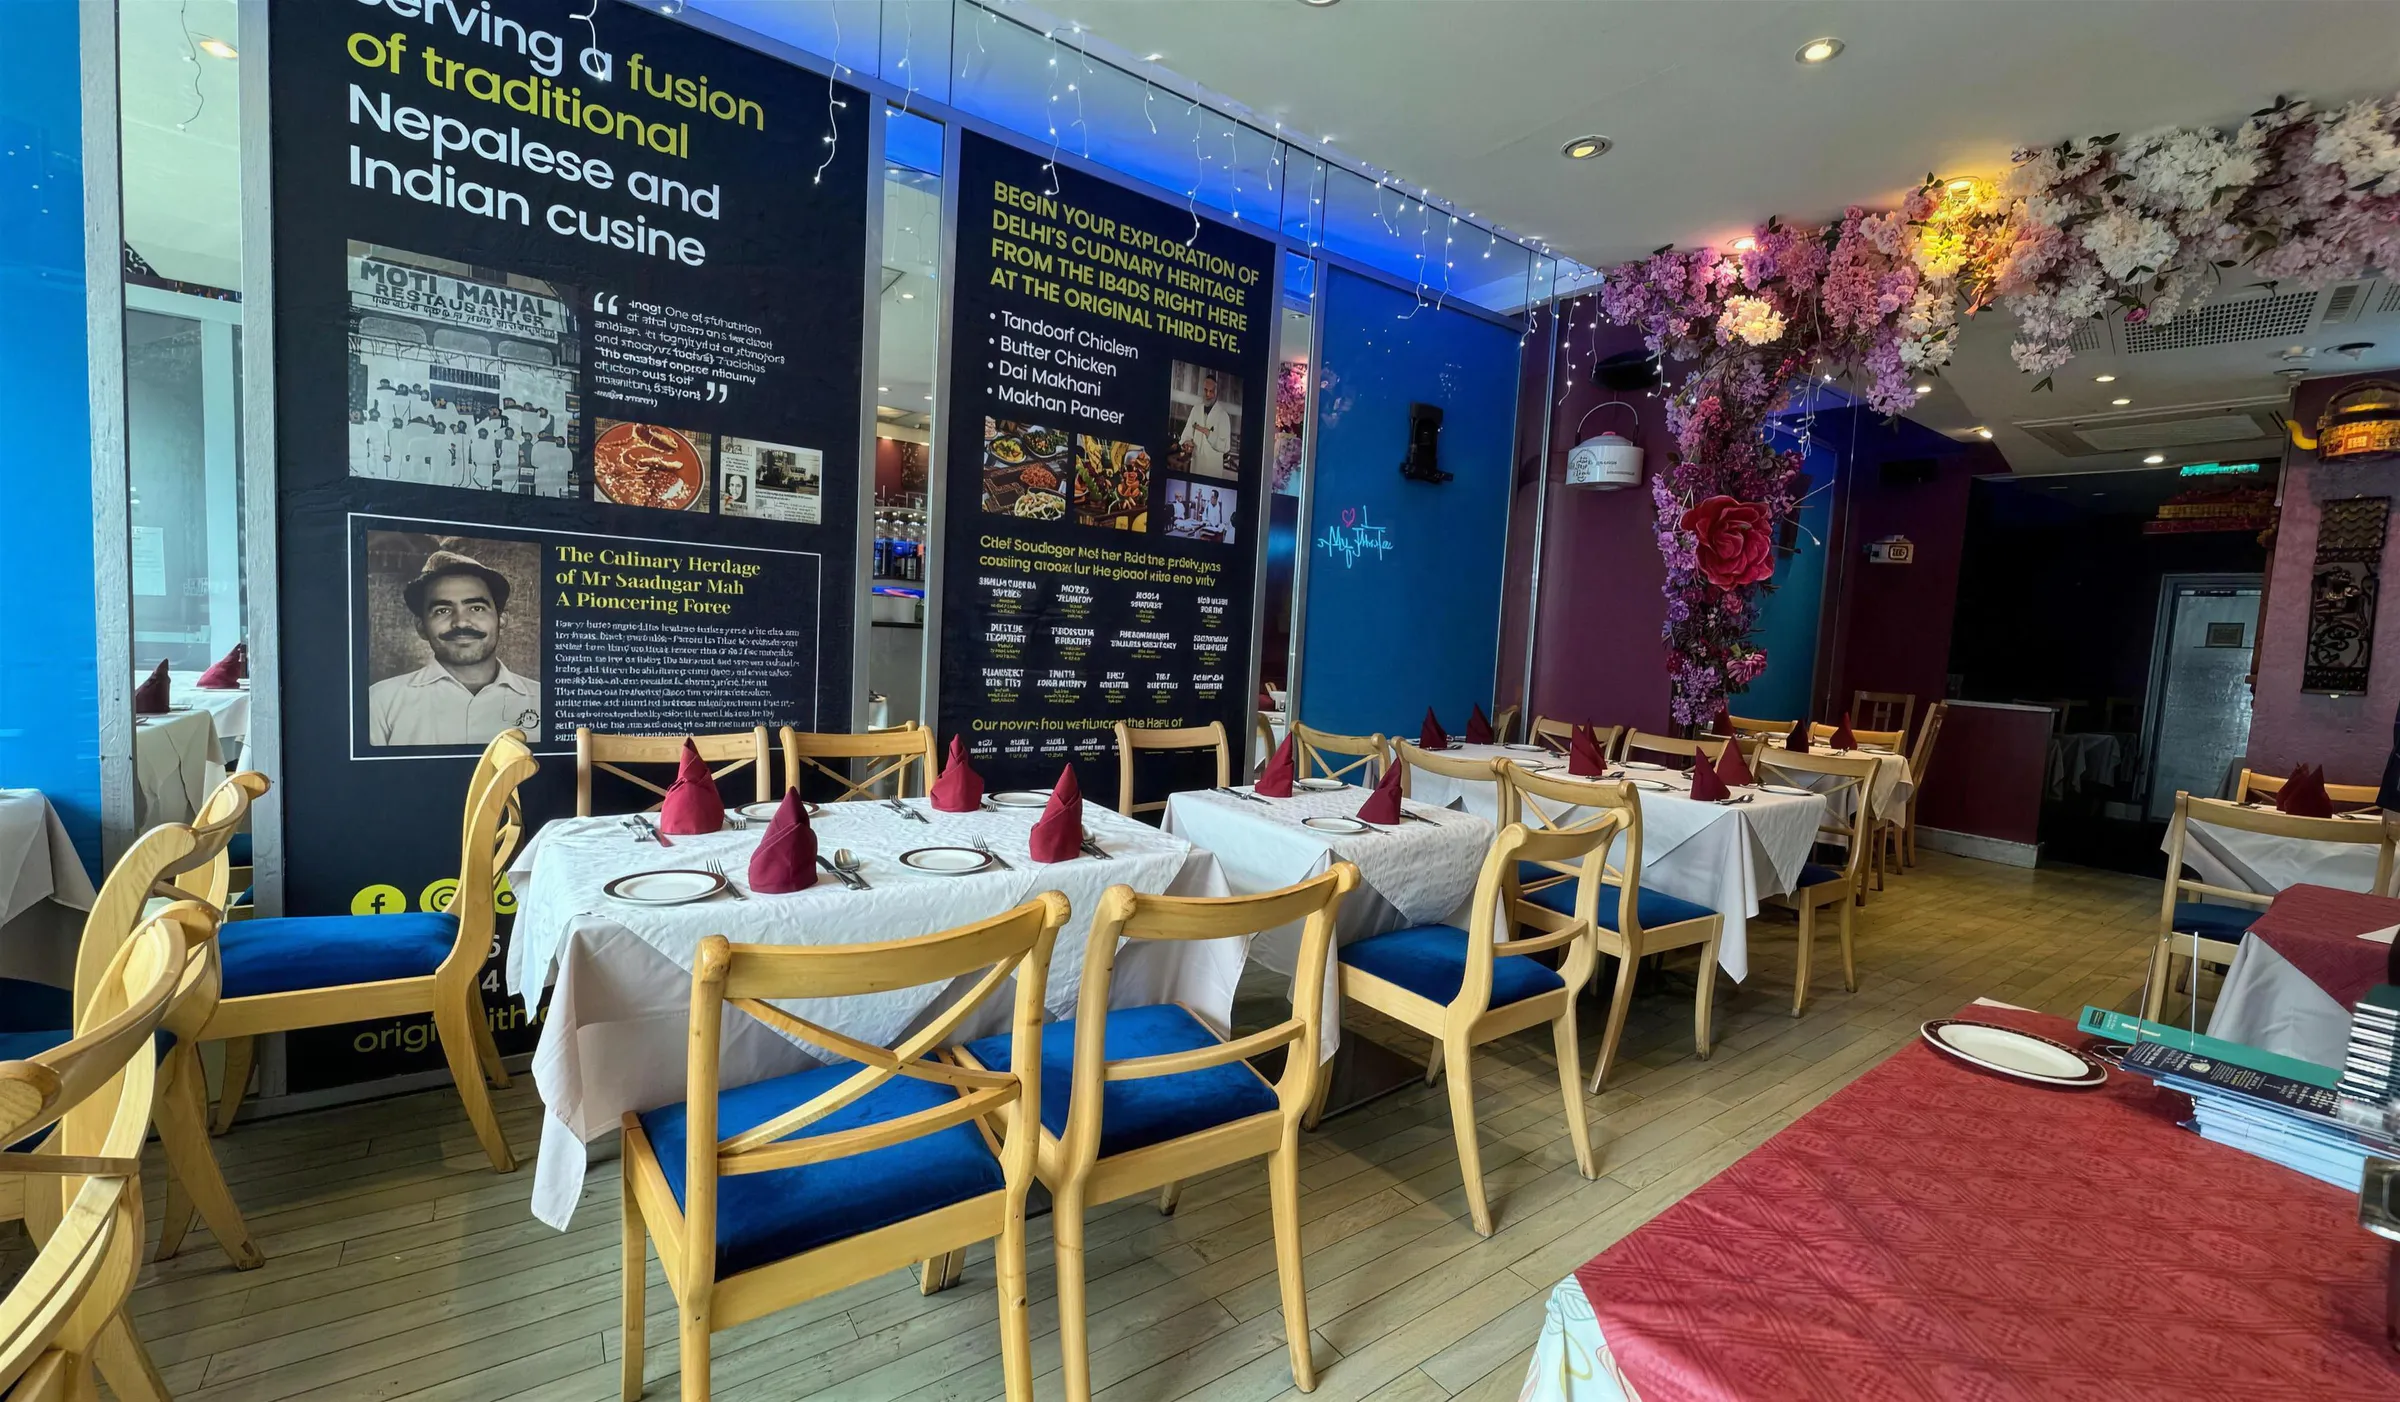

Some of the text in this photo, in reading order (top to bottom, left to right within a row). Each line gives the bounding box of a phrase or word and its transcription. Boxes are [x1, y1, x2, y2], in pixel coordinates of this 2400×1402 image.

[347, 32, 688, 159] of traditional
[355, 0, 765, 131] erving a fusion
[349, 83, 720, 221] Nepalese and
[349, 145, 706, 267] Indian cusine
[994, 180, 1260, 287] BEGIN YOUR EXPLORATION OF
[360, 261, 437, 294] MOTI
[456, 282, 553, 319] MAHAL
[991, 238, 1053, 274] FROM
[1057, 257, 1094, 286] THE
[1153, 287, 1205, 319] RIGHT
[1207, 303, 1247, 332] HERE
[993, 209, 1246, 307] DELHI'S CUDNARY HERITAGE
[990, 267, 1241, 355] AT THE ORIGINAL THIRD EYE.
[1000, 335, 1117, 377] Butter Chicken
[1000, 360, 1101, 397] Dai Makhani
[998, 385, 1125, 425] Makhan Paneer
[556, 546, 593, 563] The
[556, 569, 577, 585] of
[581, 571, 611, 587] Mr
[706, 579, 744, 595] Mah
[556, 591, 571, 607] A
